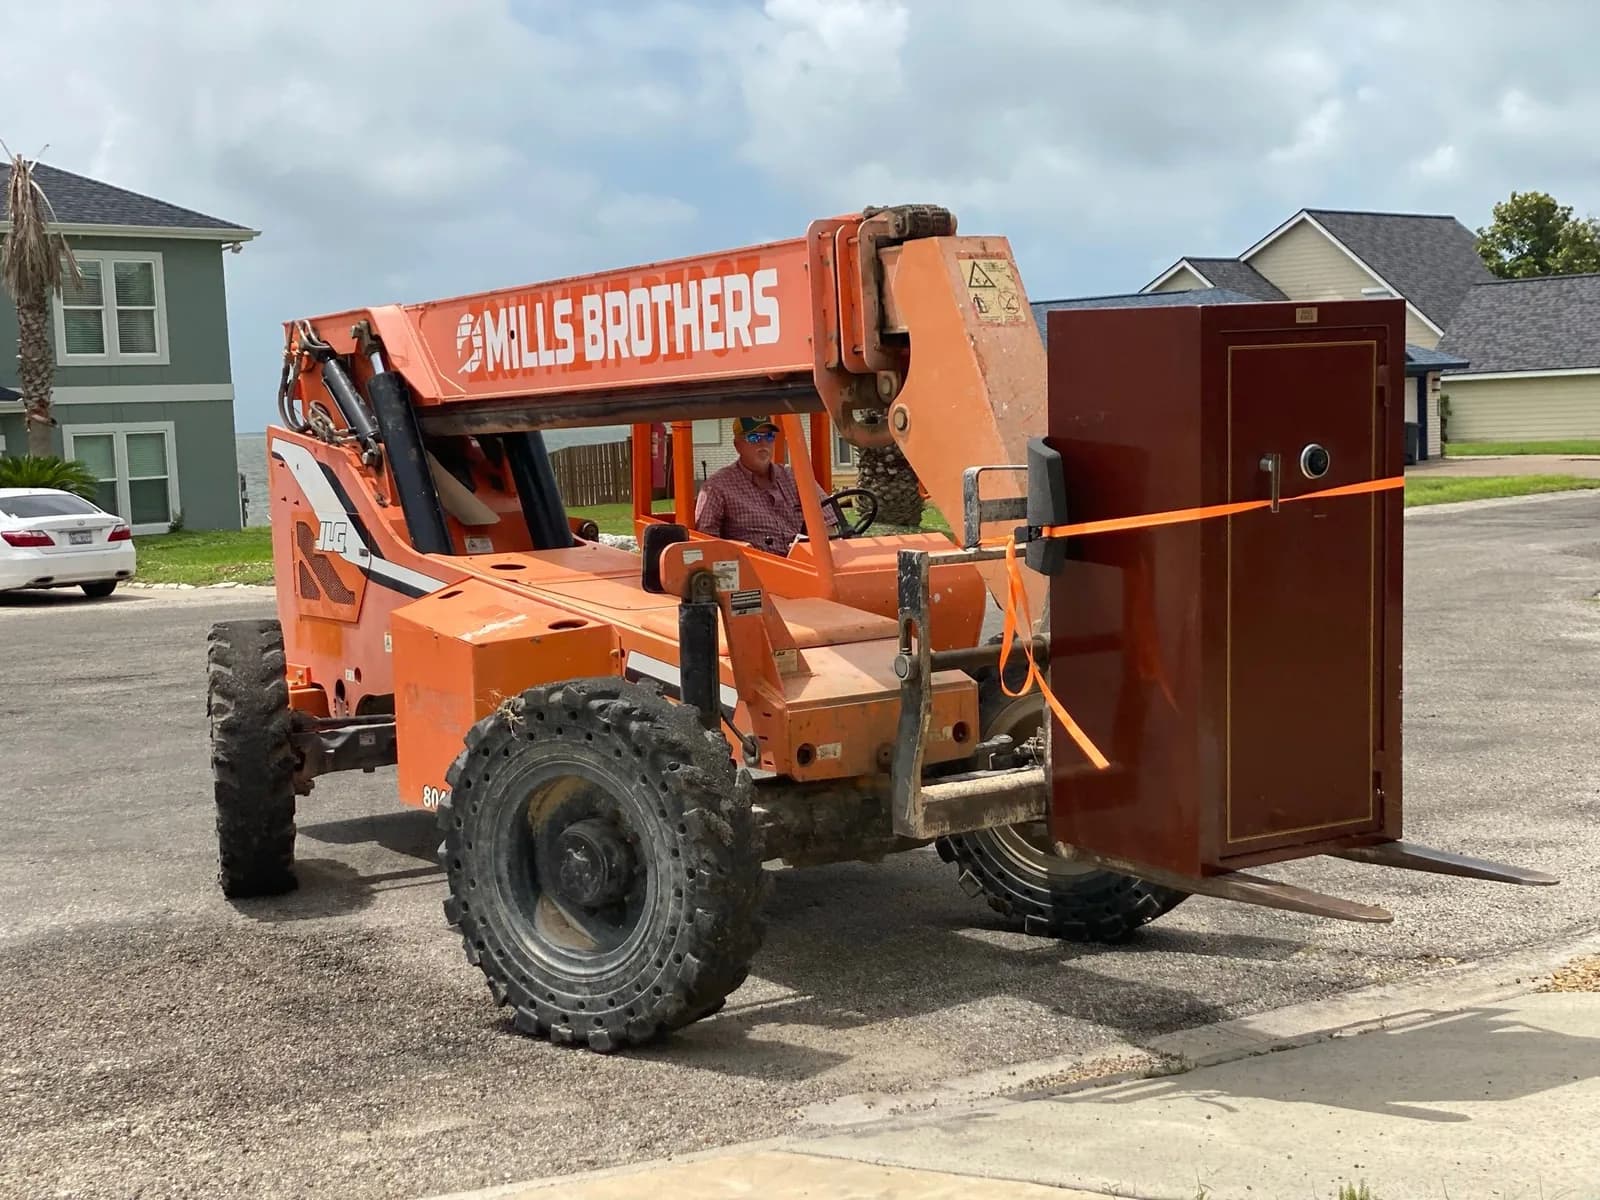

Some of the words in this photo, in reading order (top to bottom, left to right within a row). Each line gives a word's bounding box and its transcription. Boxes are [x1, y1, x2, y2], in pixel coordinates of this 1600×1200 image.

[484, 298, 575, 372] MILLS
[582, 268, 781, 361] BROTHERS
[314, 520, 347, 553] JLG
